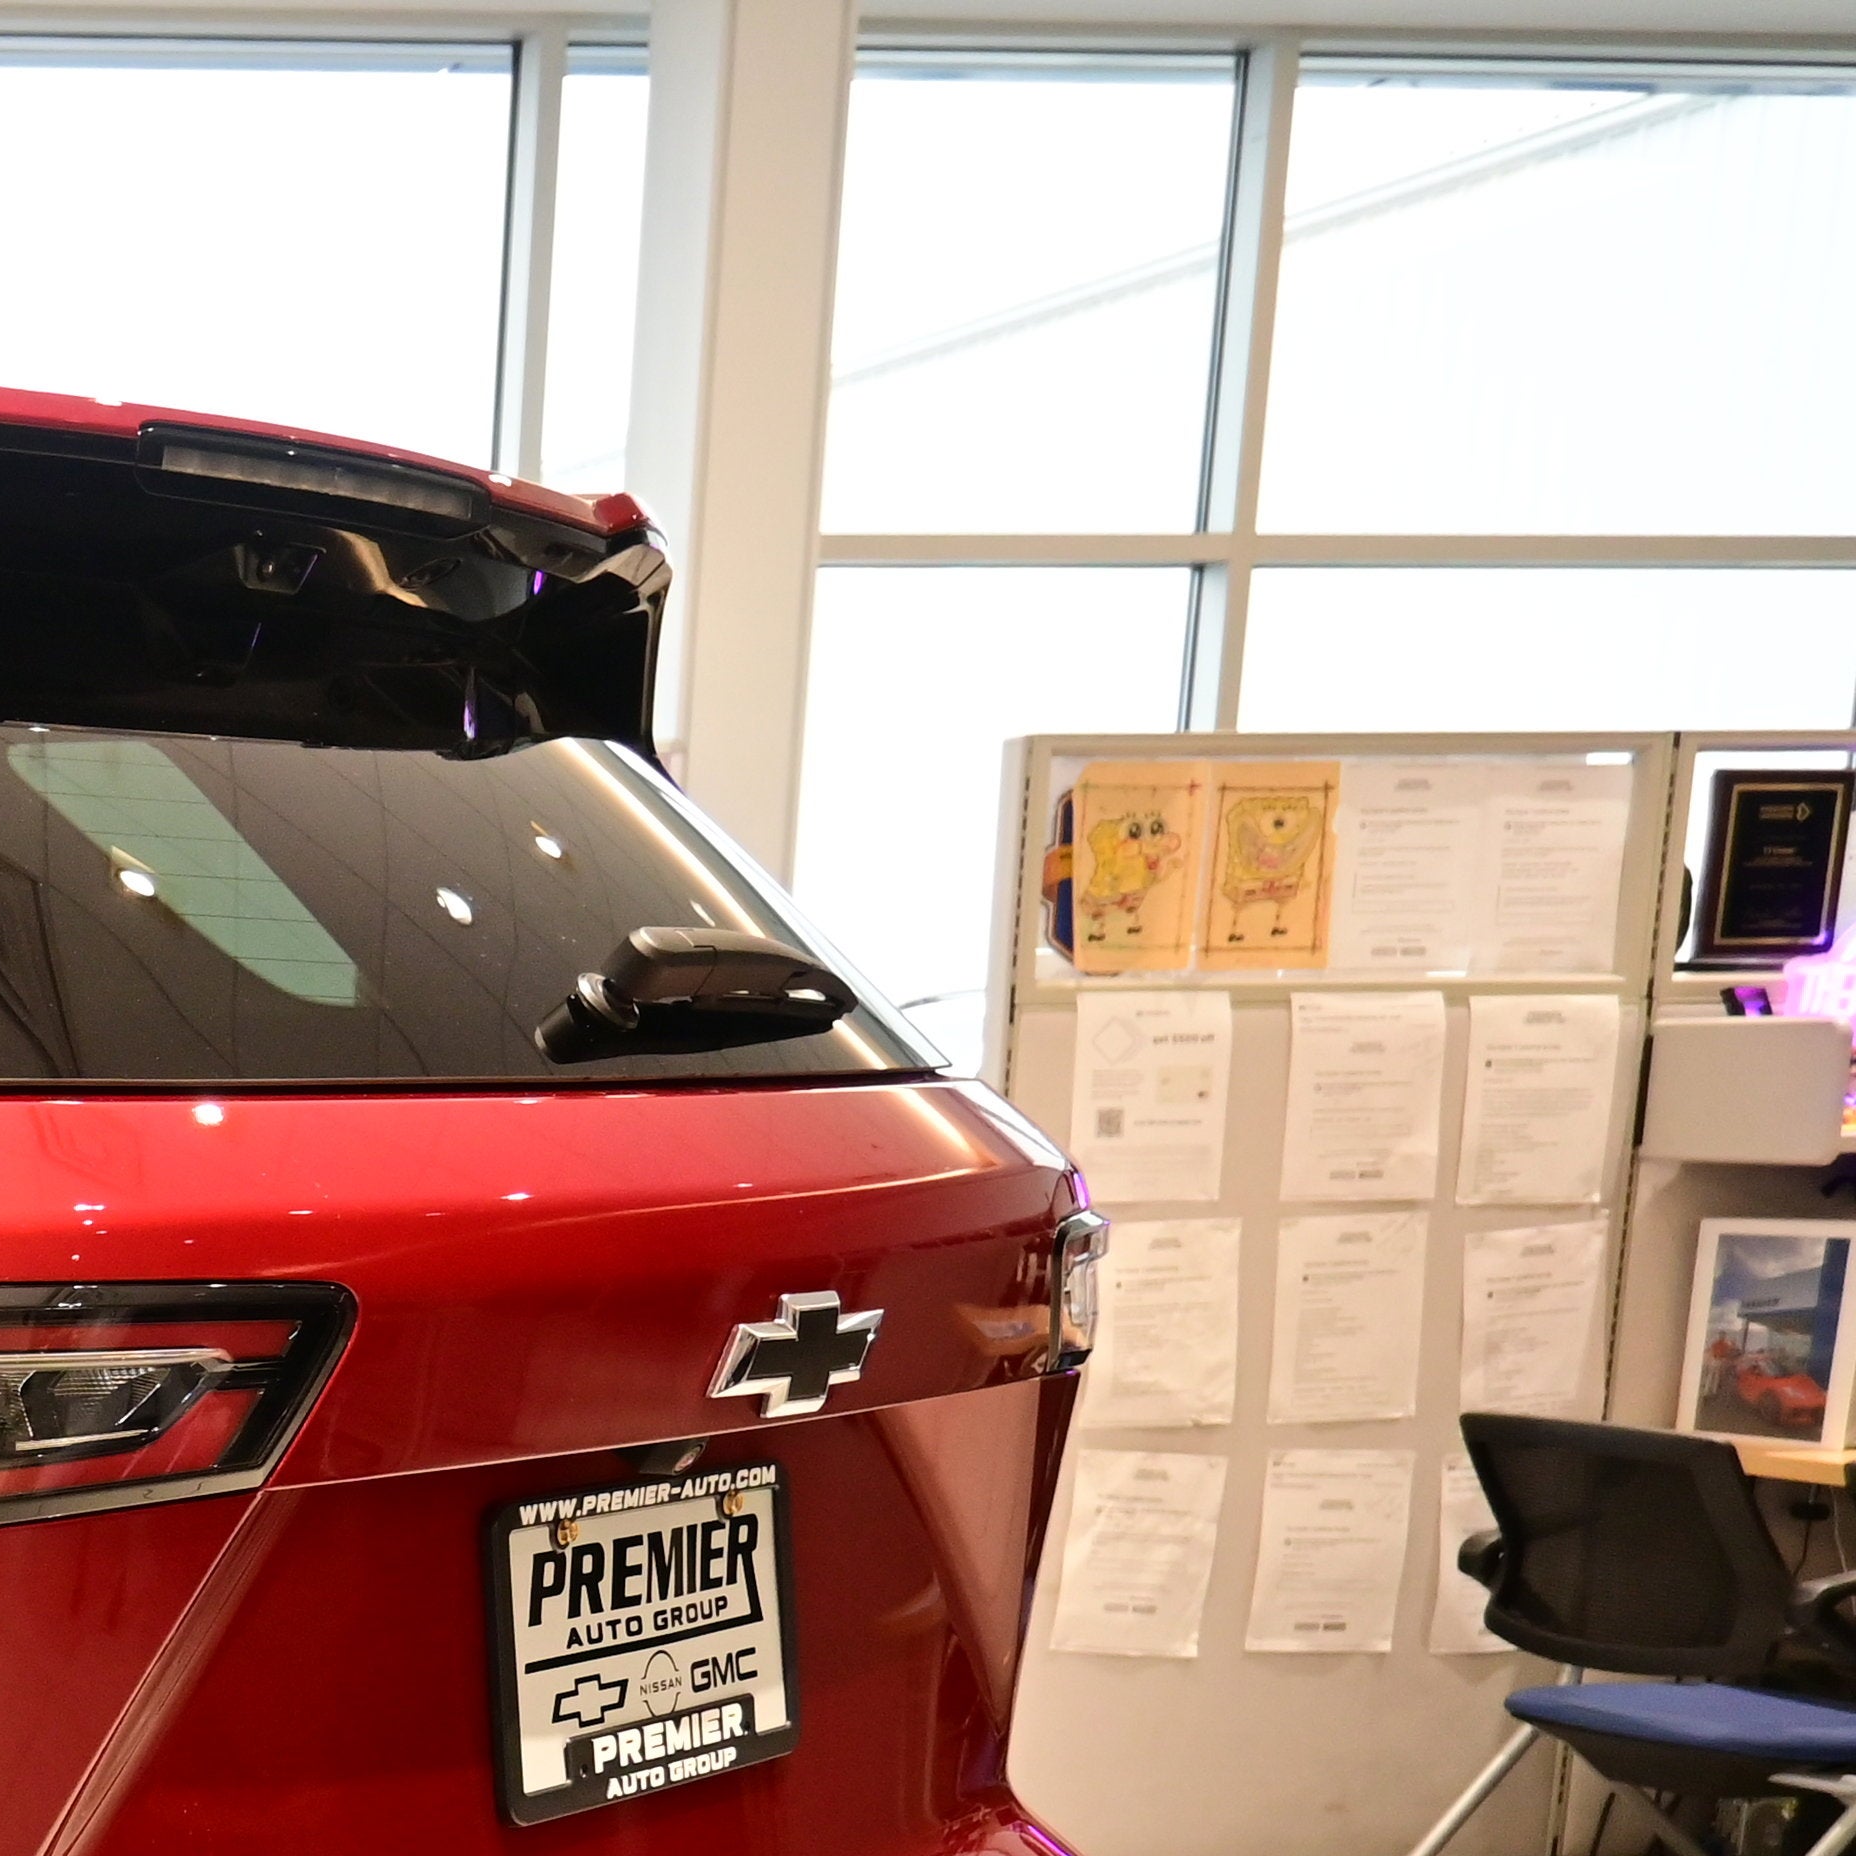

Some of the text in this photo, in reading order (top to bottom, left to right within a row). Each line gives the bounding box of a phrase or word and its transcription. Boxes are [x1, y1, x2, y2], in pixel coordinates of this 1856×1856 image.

[519, 1465, 777, 1525] WWW.PREMIER-AUTO.COM
[528, 1513, 763, 1628] PREMIER
[566, 1596, 728, 1650] AUTO GROUP
[639, 1647, 758, 1696] NISSAN GMC
[592, 1703, 744, 1775] PREMIER
[606, 1747, 737, 1800] AUTO GROUP
